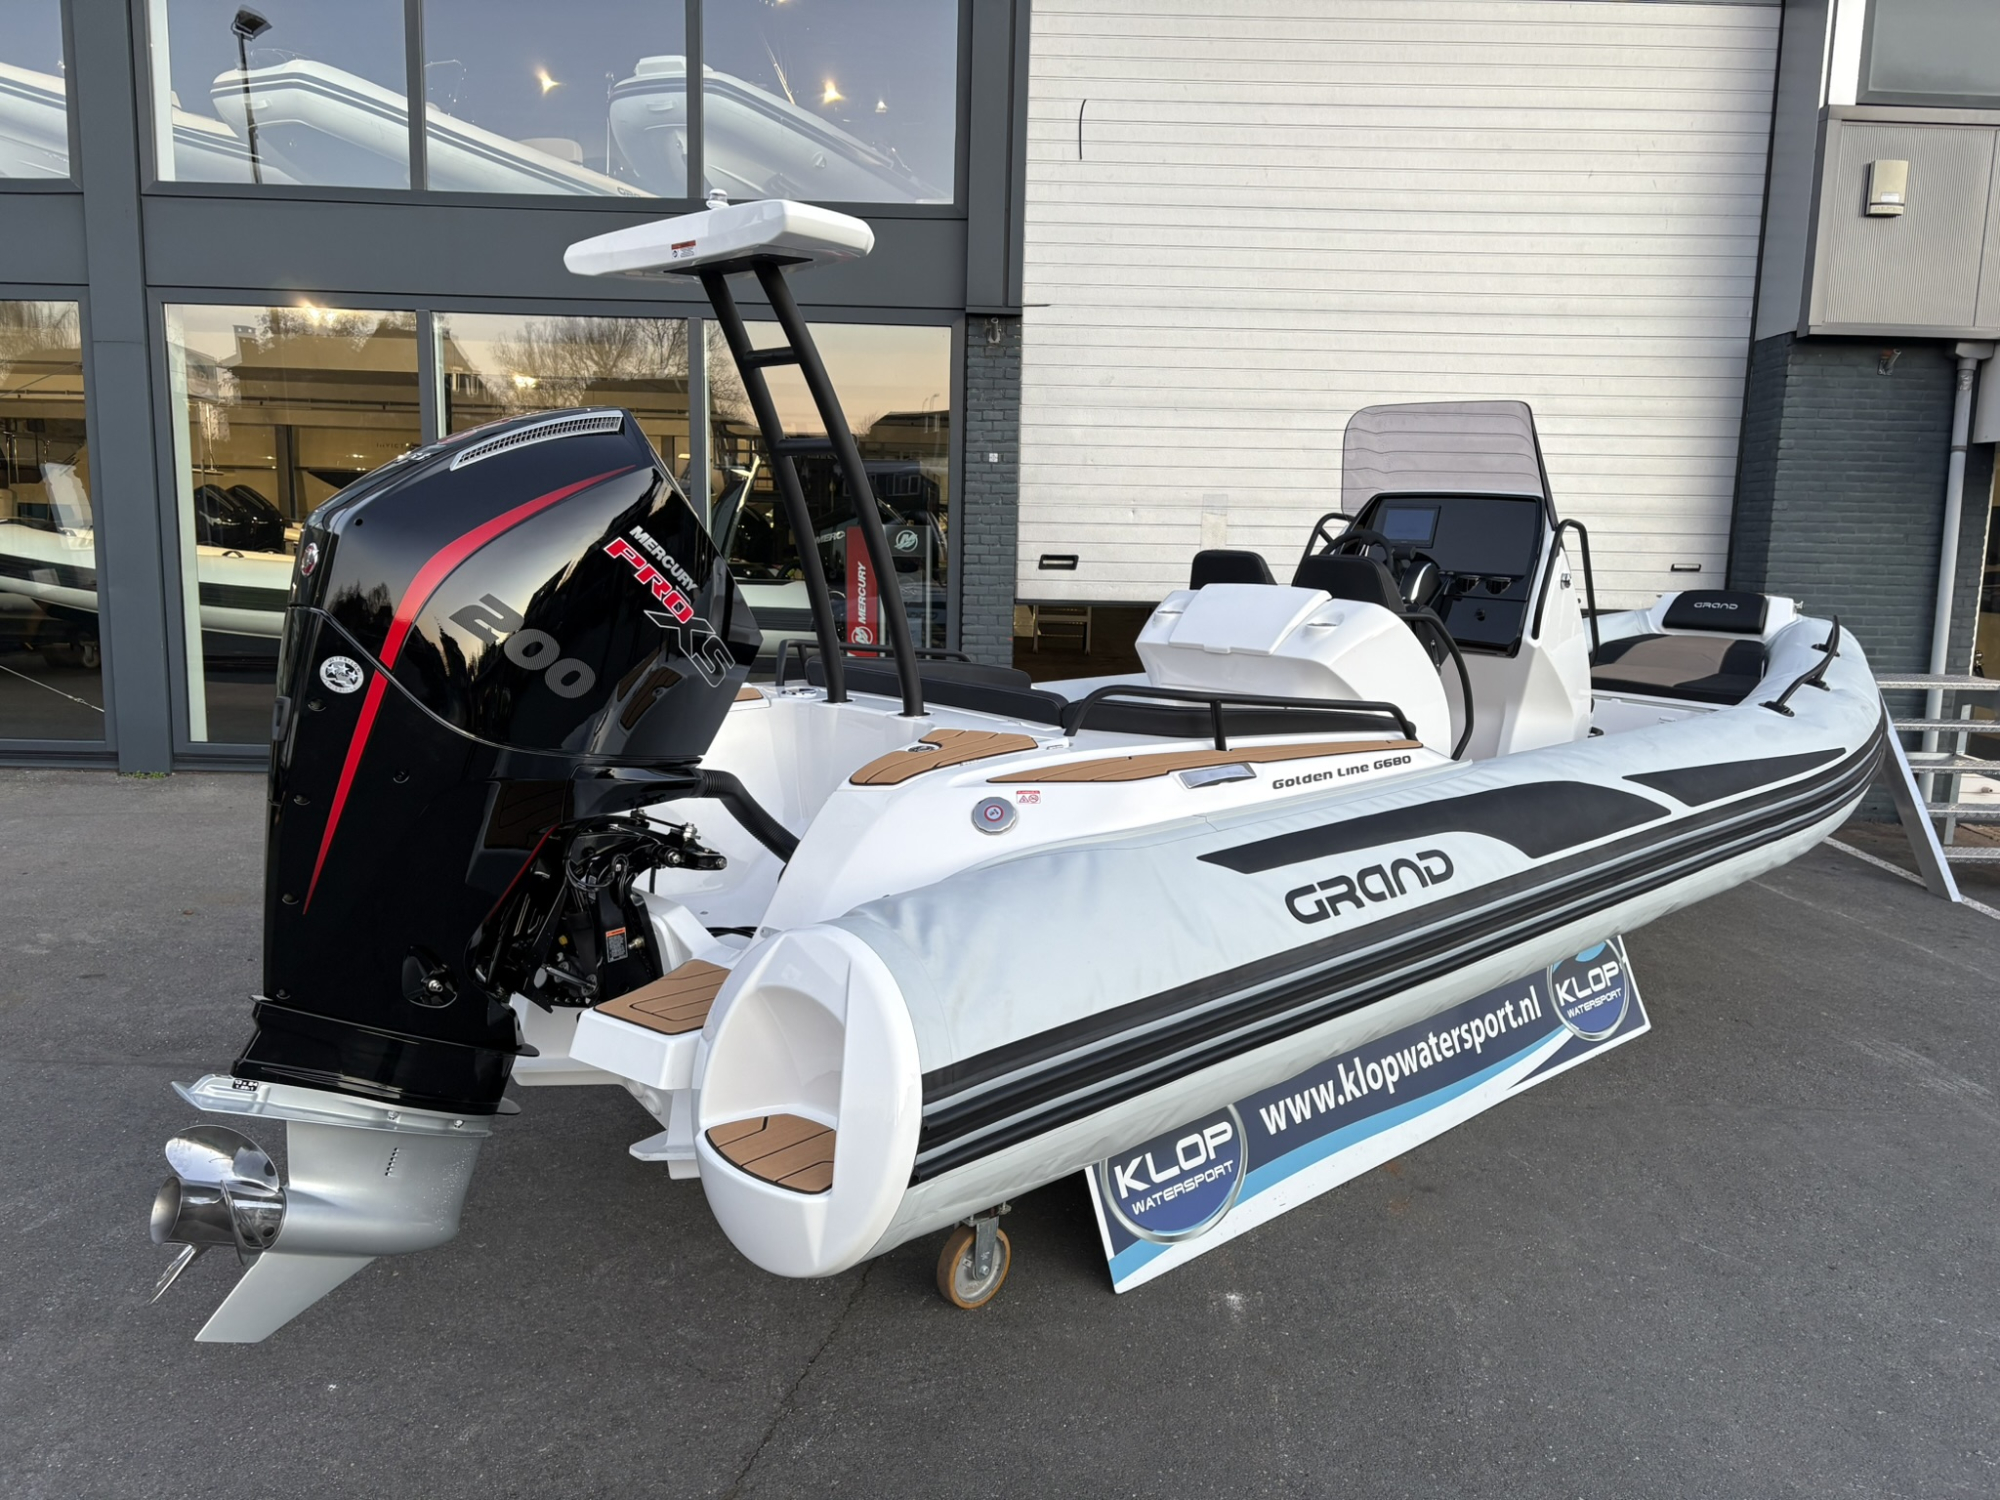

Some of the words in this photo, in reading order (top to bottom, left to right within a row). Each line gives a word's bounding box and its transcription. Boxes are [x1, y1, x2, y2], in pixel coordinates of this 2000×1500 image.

[603, 536, 694, 624] PRO
[629, 525, 699, 592] MERCURY
[857, 561, 866, 624] MERCURY
[1693, 601, 1738, 610] GRAND
[448, 593, 597, 699] 200
[644, 585, 736, 687] XS
[1272, 771, 1333, 789] Golden
[1337, 764, 1369, 777] Line
[1373, 755, 1411, 770] G680
[1285, 849, 1454, 924] GRAND
[1555, 960, 1619, 1006] KLOP
[1566, 987, 1622, 1018] WATERSPORT
[1259, 985, 1542, 1136] www.klopwatersport.nl
[1113, 1121, 1233, 1199] KLOP
[1132, 1160, 1233, 1215] WATERSPORT
